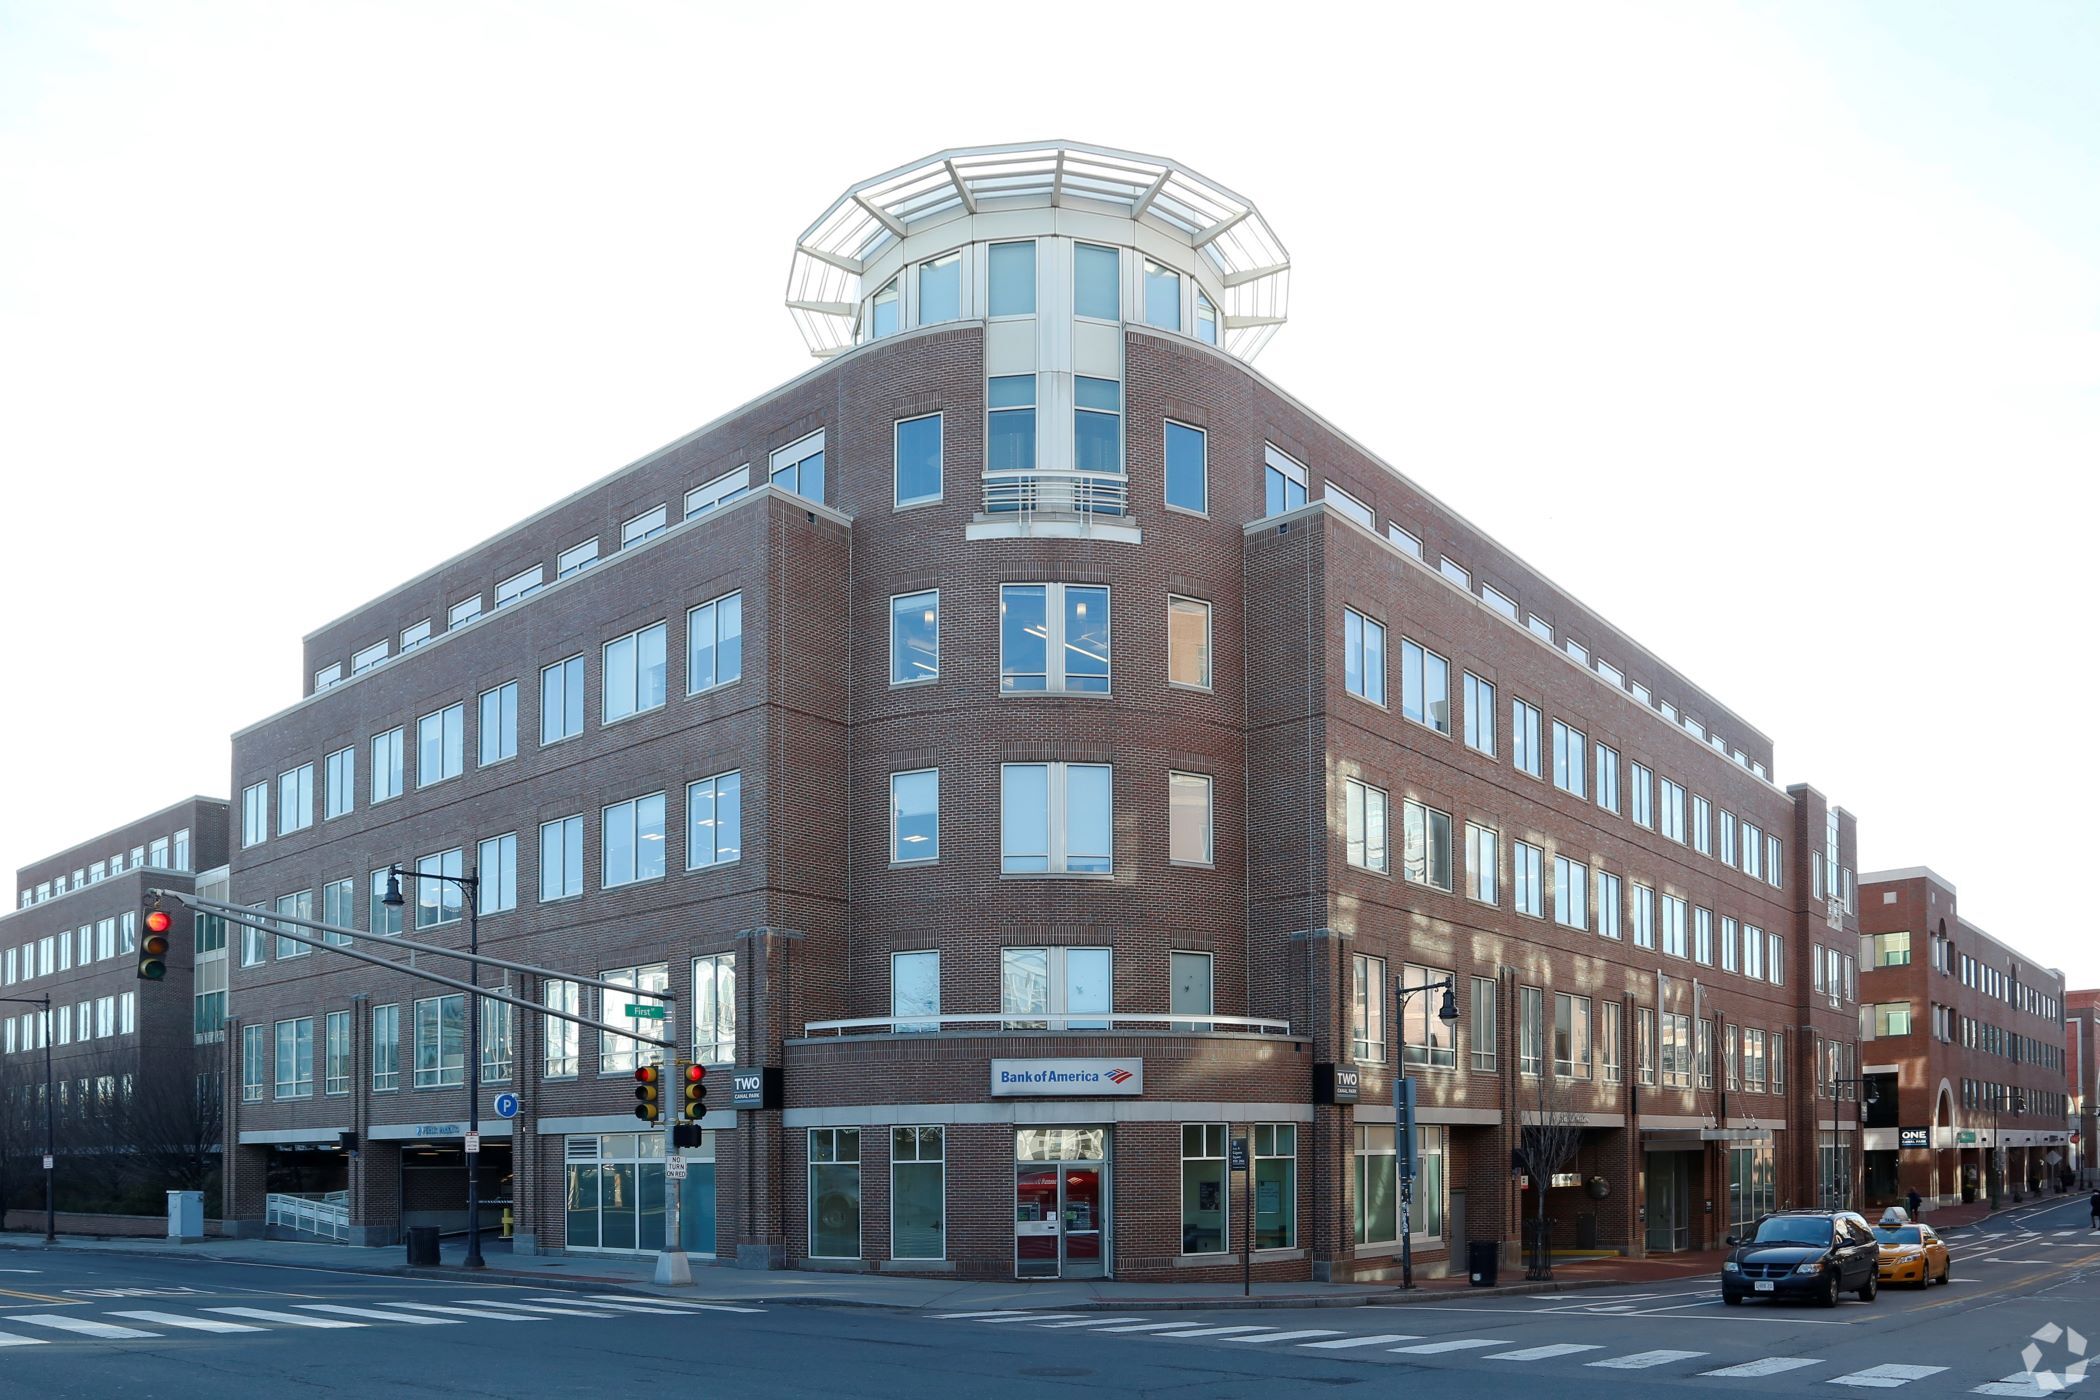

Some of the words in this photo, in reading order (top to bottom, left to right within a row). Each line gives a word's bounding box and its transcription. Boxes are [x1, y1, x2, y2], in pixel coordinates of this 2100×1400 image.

[634, 1006, 651, 1017] First
[1001, 1071, 1033, 1083] Bank
[1034, 1071, 1047, 1083] of
[1049, 1070, 1099, 1083] America
[1337, 1072, 1358, 1086] TWO
[734, 1077, 760, 1090] TWO
[503, 1099, 512, 1113] P
[1901, 1131, 1927, 1139] ONE
